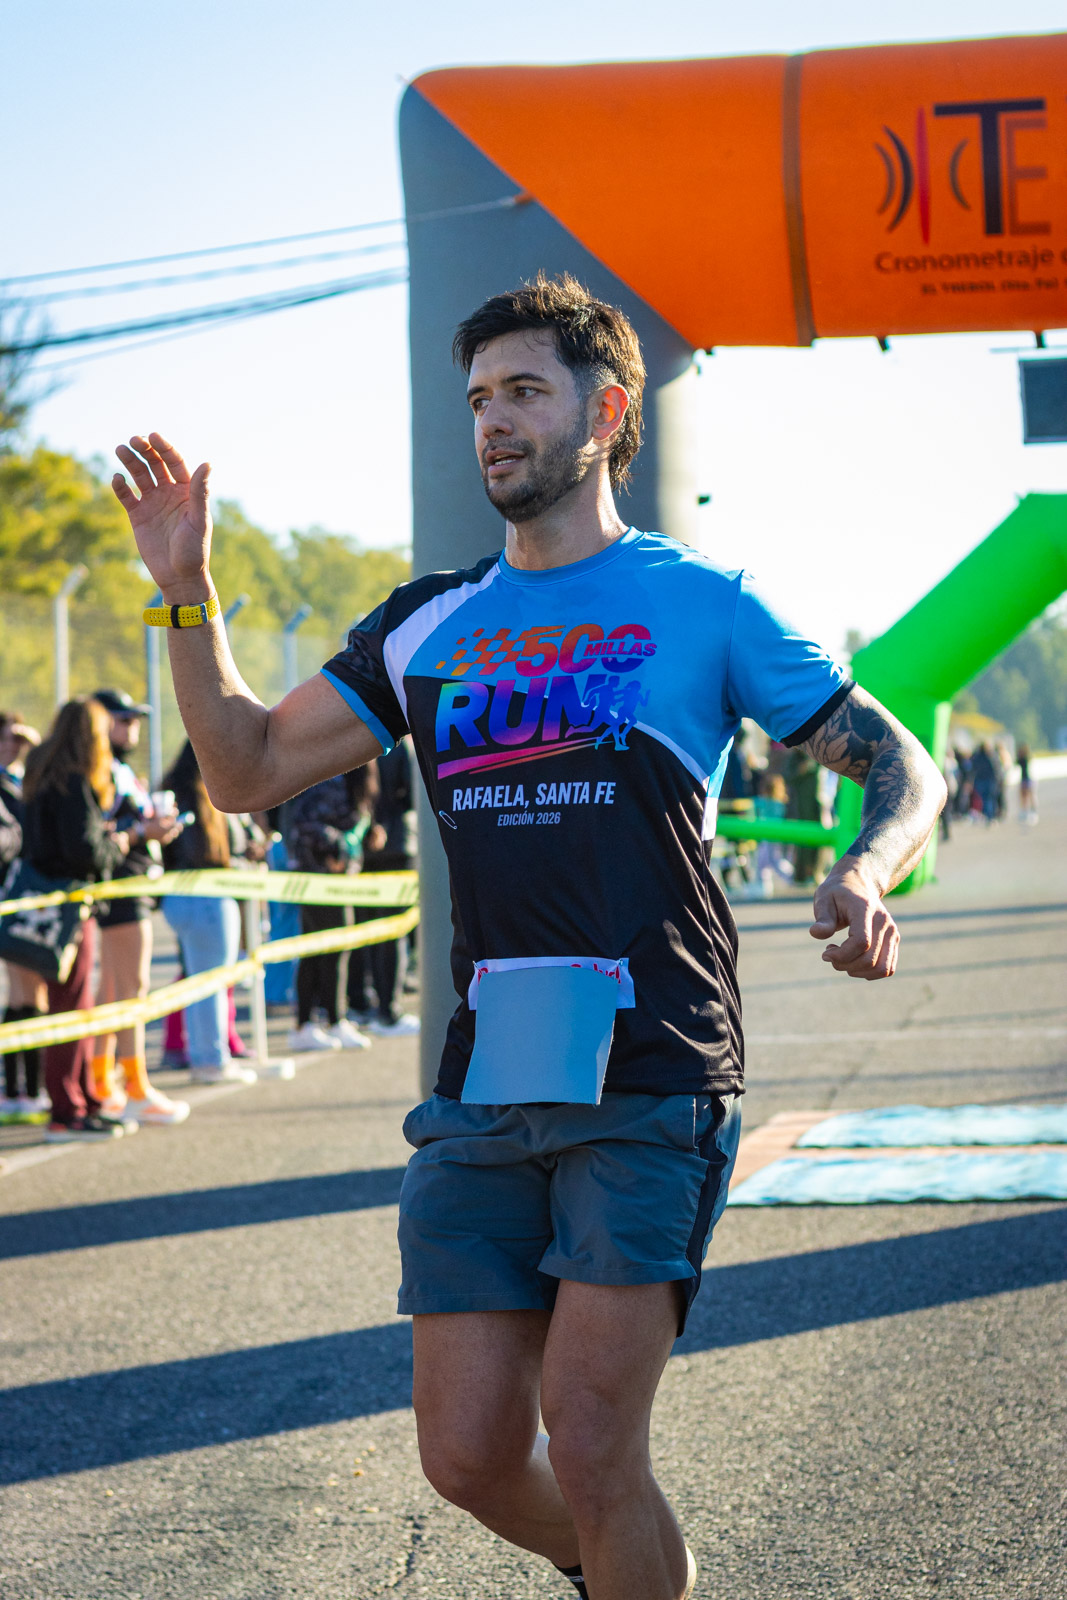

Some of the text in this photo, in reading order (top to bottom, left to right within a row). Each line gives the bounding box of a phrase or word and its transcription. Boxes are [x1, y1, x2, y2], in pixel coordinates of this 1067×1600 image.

[875, 246, 1054, 274] Cronometraje
[515, 623, 652, 677] 500
[583, 641, 658, 657] MILLAS
[435, 674, 607, 752] RUN
[452, 781, 617, 812] RAFAELA, SANTA FE
[497, 810, 561, 826] EDICIÓN 2026
